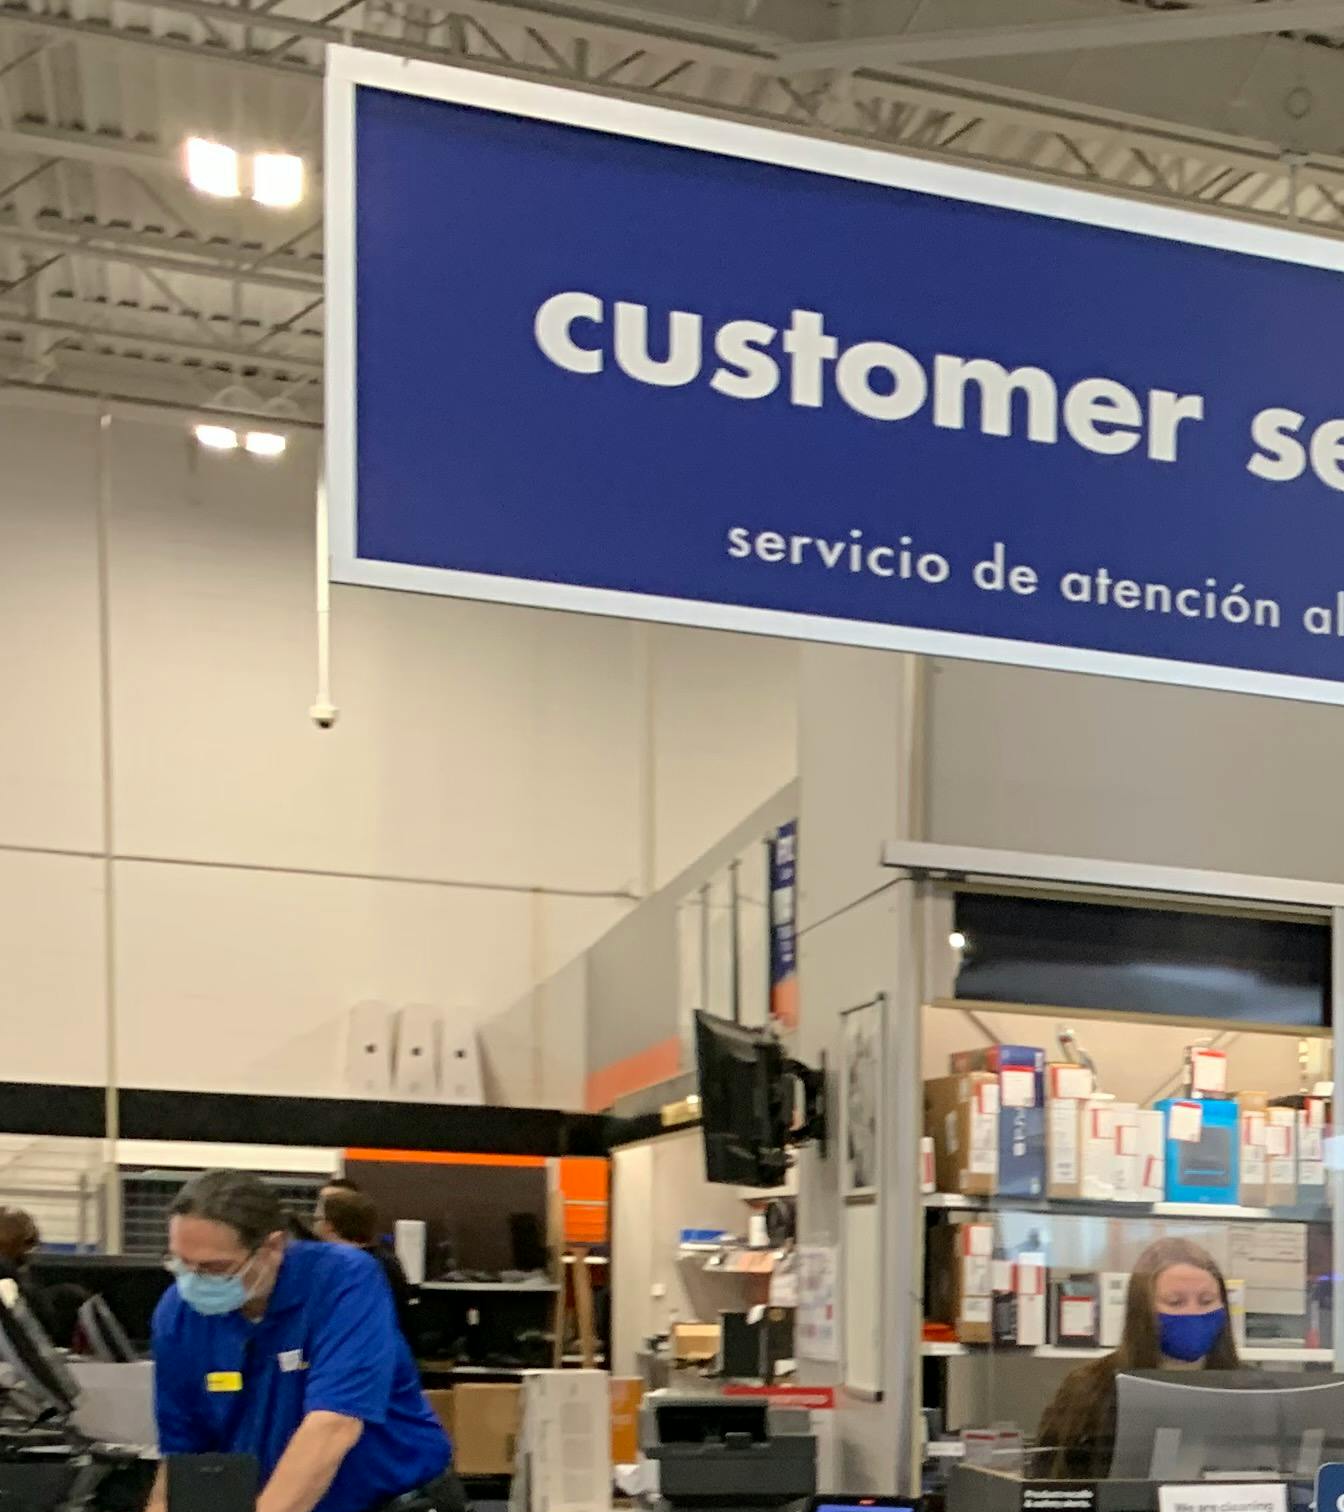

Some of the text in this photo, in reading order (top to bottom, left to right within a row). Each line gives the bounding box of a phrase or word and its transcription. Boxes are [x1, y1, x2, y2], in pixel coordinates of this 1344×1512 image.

[534, 291, 1204, 463] customer
[727, 526, 950, 583] servicio
[972, 542, 1039, 596] de
[1061, 568, 1280, 628] atención
